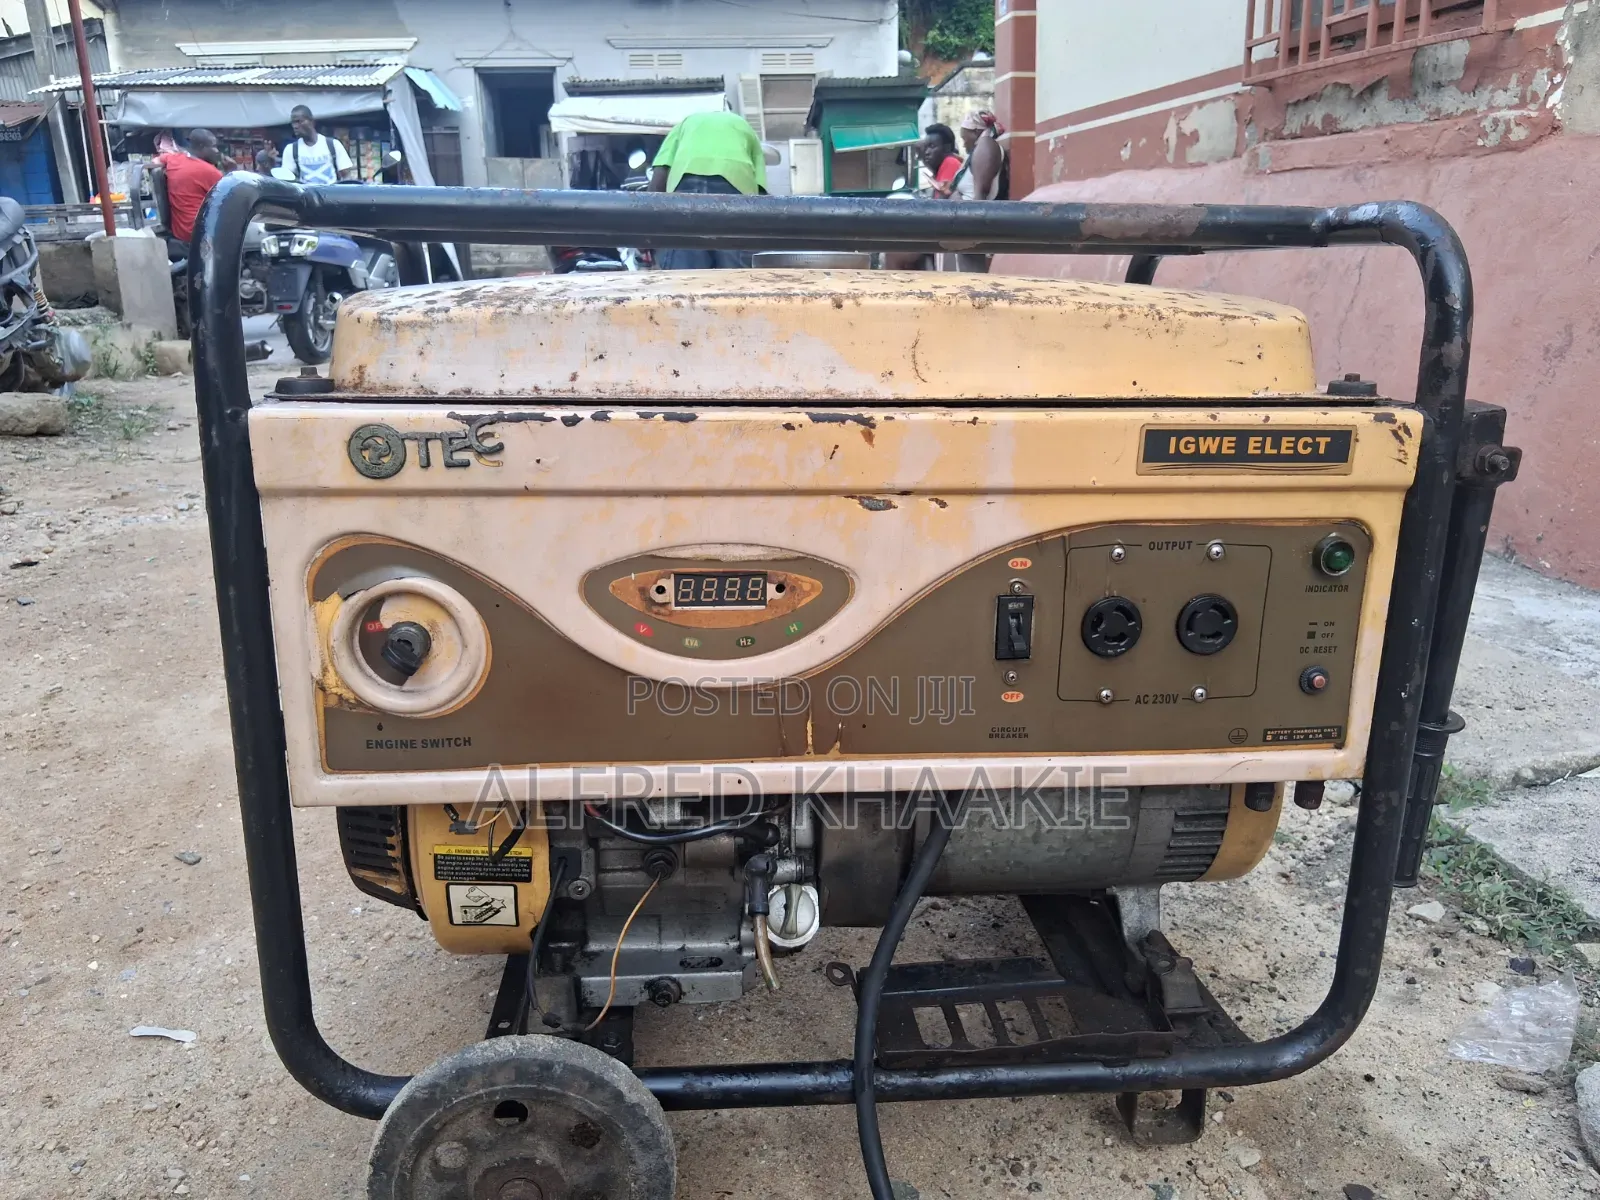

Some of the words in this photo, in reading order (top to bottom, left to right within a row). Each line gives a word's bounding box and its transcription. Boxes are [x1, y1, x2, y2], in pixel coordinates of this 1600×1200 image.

[1168, 436, 1237, 455] IGWE
[1247, 436, 1331, 455] ELECT
[1148, 540, 1193, 551] OUTPUT
[1010, 560, 1028, 568] ON
[1304, 584, 1349, 593] INDICATOR
[639, 624, 648, 633] V
[788, 623, 798, 633] H
[1299, 646, 1310, 654] DC
[1313, 645, 1338, 654] RESET
[1134, 694, 1149, 705] AC
[1152, 693, 1179, 705] 230V
[366, 738, 418, 750] ENGINE
[421, 737, 472, 749] SWITCH
